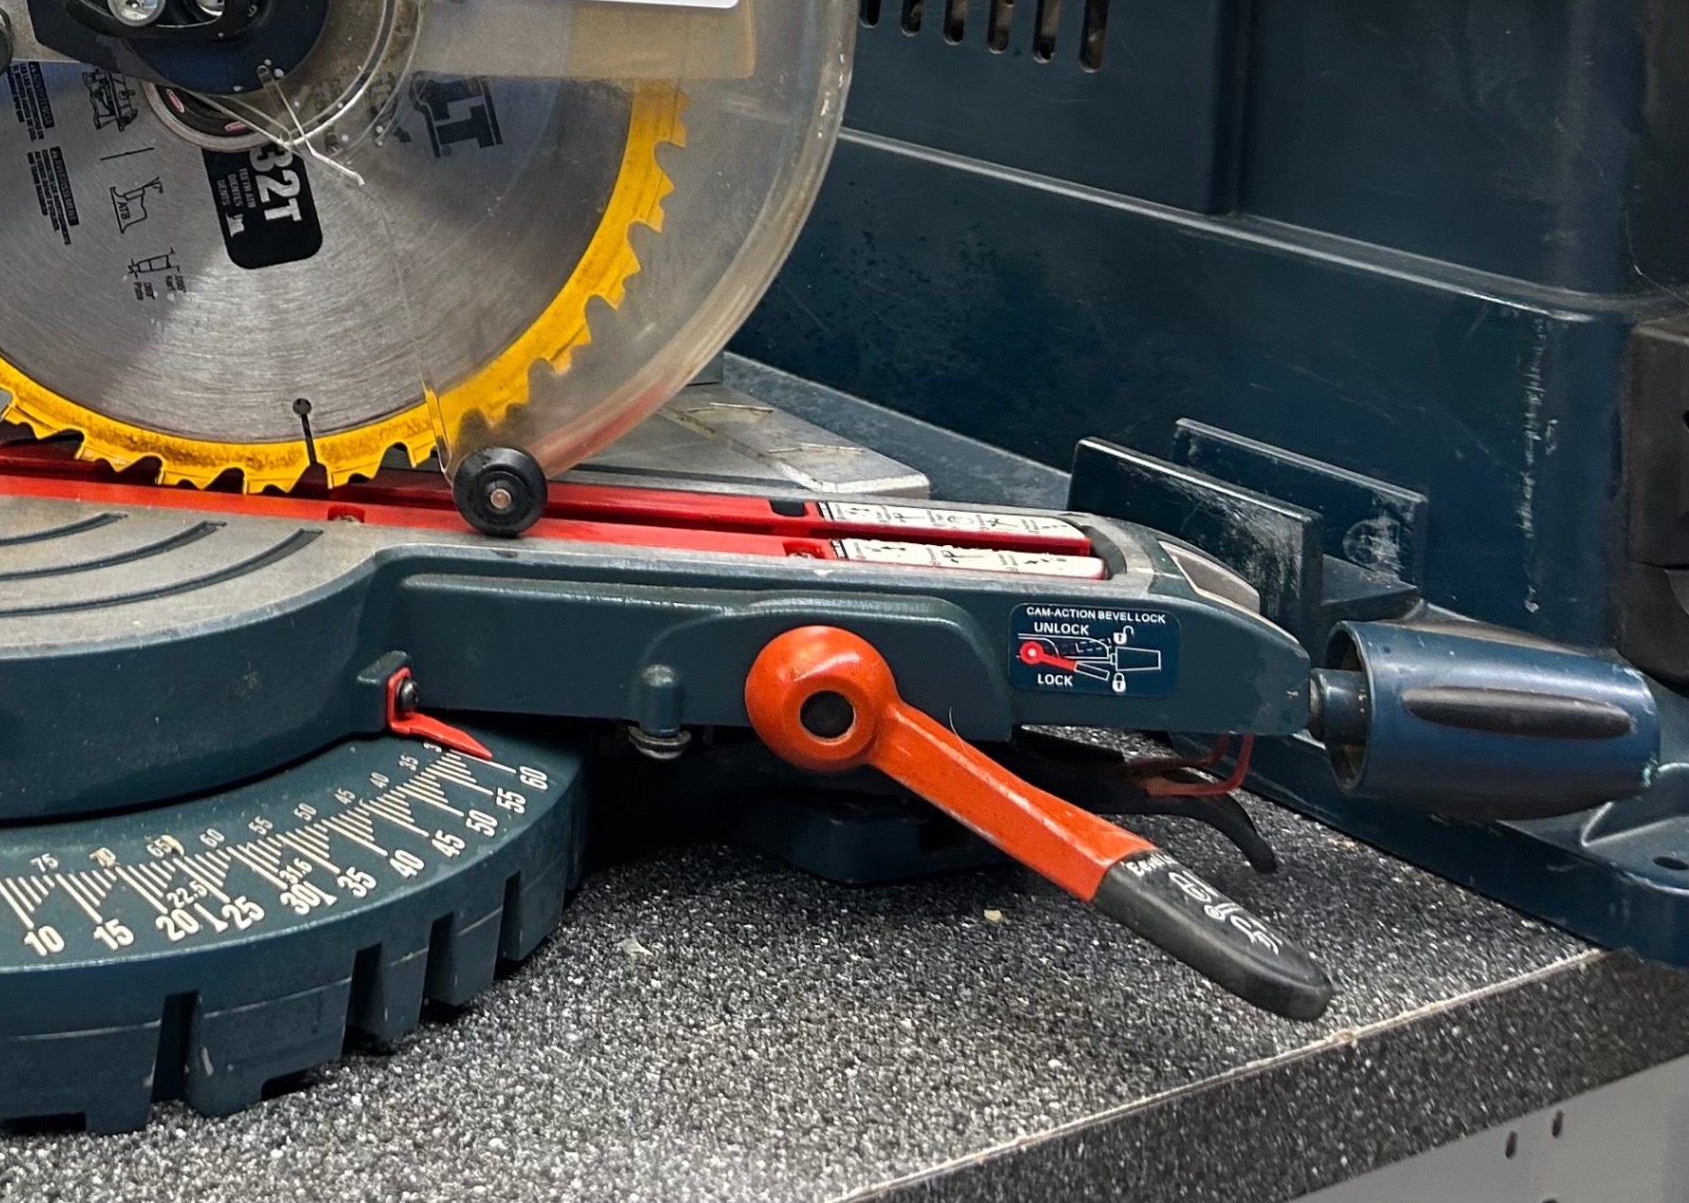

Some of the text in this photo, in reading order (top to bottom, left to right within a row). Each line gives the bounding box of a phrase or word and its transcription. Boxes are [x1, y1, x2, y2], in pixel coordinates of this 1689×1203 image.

[117, 200, 130, 220] ATB
[1026, 606, 1166, 624] CAM-ACTION BEVEL LOCK
[1033, 621, 1090, 636] UNLOCK
[1037, 673, 1074, 687] LOCK
[30, 852, 59, 873] 75
[198, 828, 226, 848] 60
[248, 815, 274, 836] 55
[292, 803, 317, 822] 50
[334, 787, 357, 806] 45
[368, 771, 391, 790] 40
[398, 753, 419, 771] 35
[24, 925, 66, 956] 10
[93, 918, 135, 951] 15
[154, 909, 200, 943] 20
[221, 895, 266, 930] 25
[279, 881, 321, 916] 30
[337, 866, 378, 900] 35
[389, 848, 425, 880] 40
[431, 828, 466, 860] 45
[466, 809, 499, 838] 50
[496, 786, 527, 815] 55
[519, 765, 549, 791] 60
[279, 857, 314, 884] 31.6
[165, 880, 209, 909] 22.5
